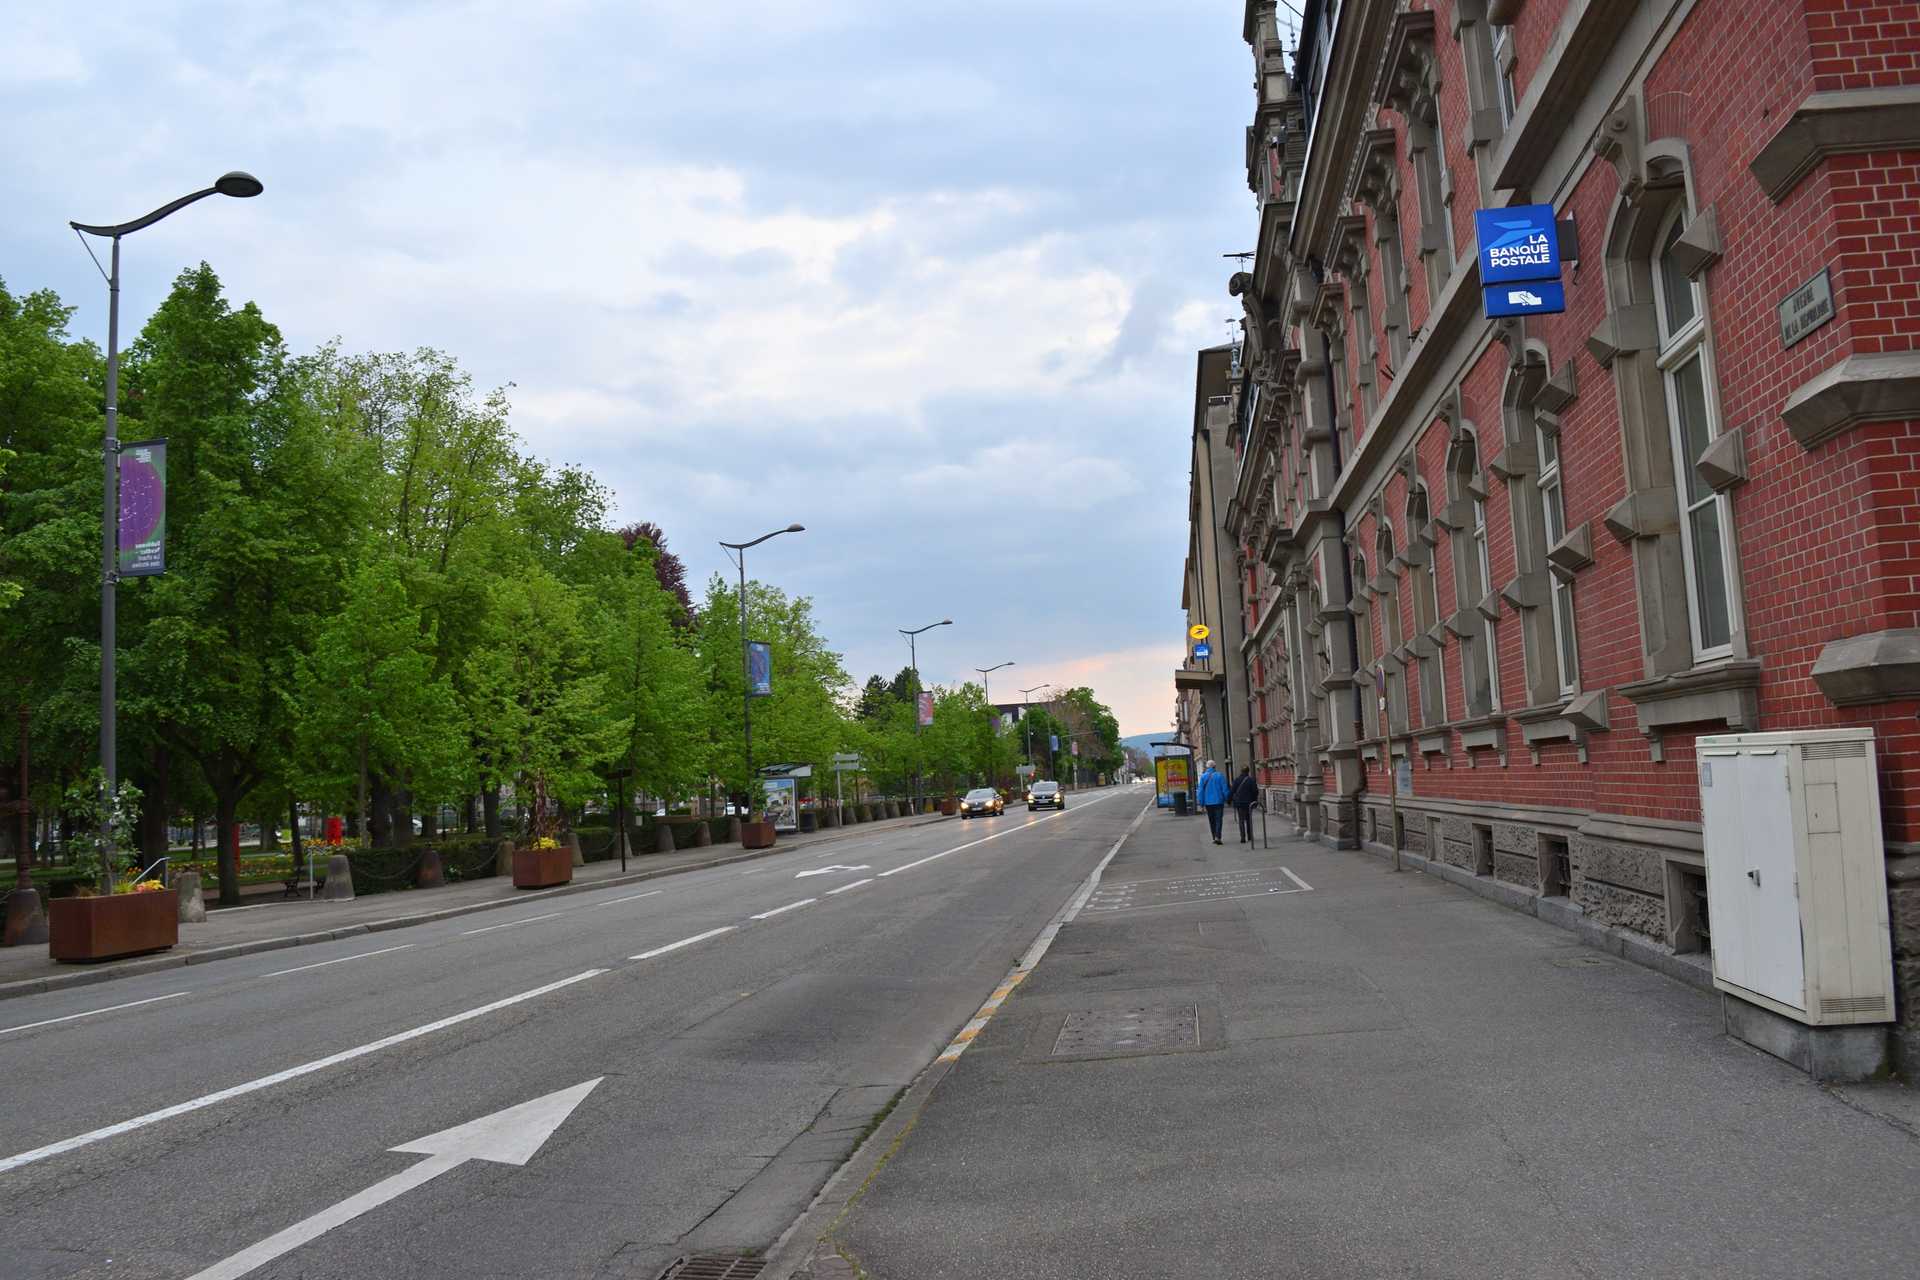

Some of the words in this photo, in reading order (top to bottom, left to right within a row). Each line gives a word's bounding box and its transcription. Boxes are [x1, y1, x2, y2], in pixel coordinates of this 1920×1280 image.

[1529, 234, 1548, 244] LA
[1490, 244, 1549, 257] BANQUE
[1491, 254, 1551, 267] POSTALE
